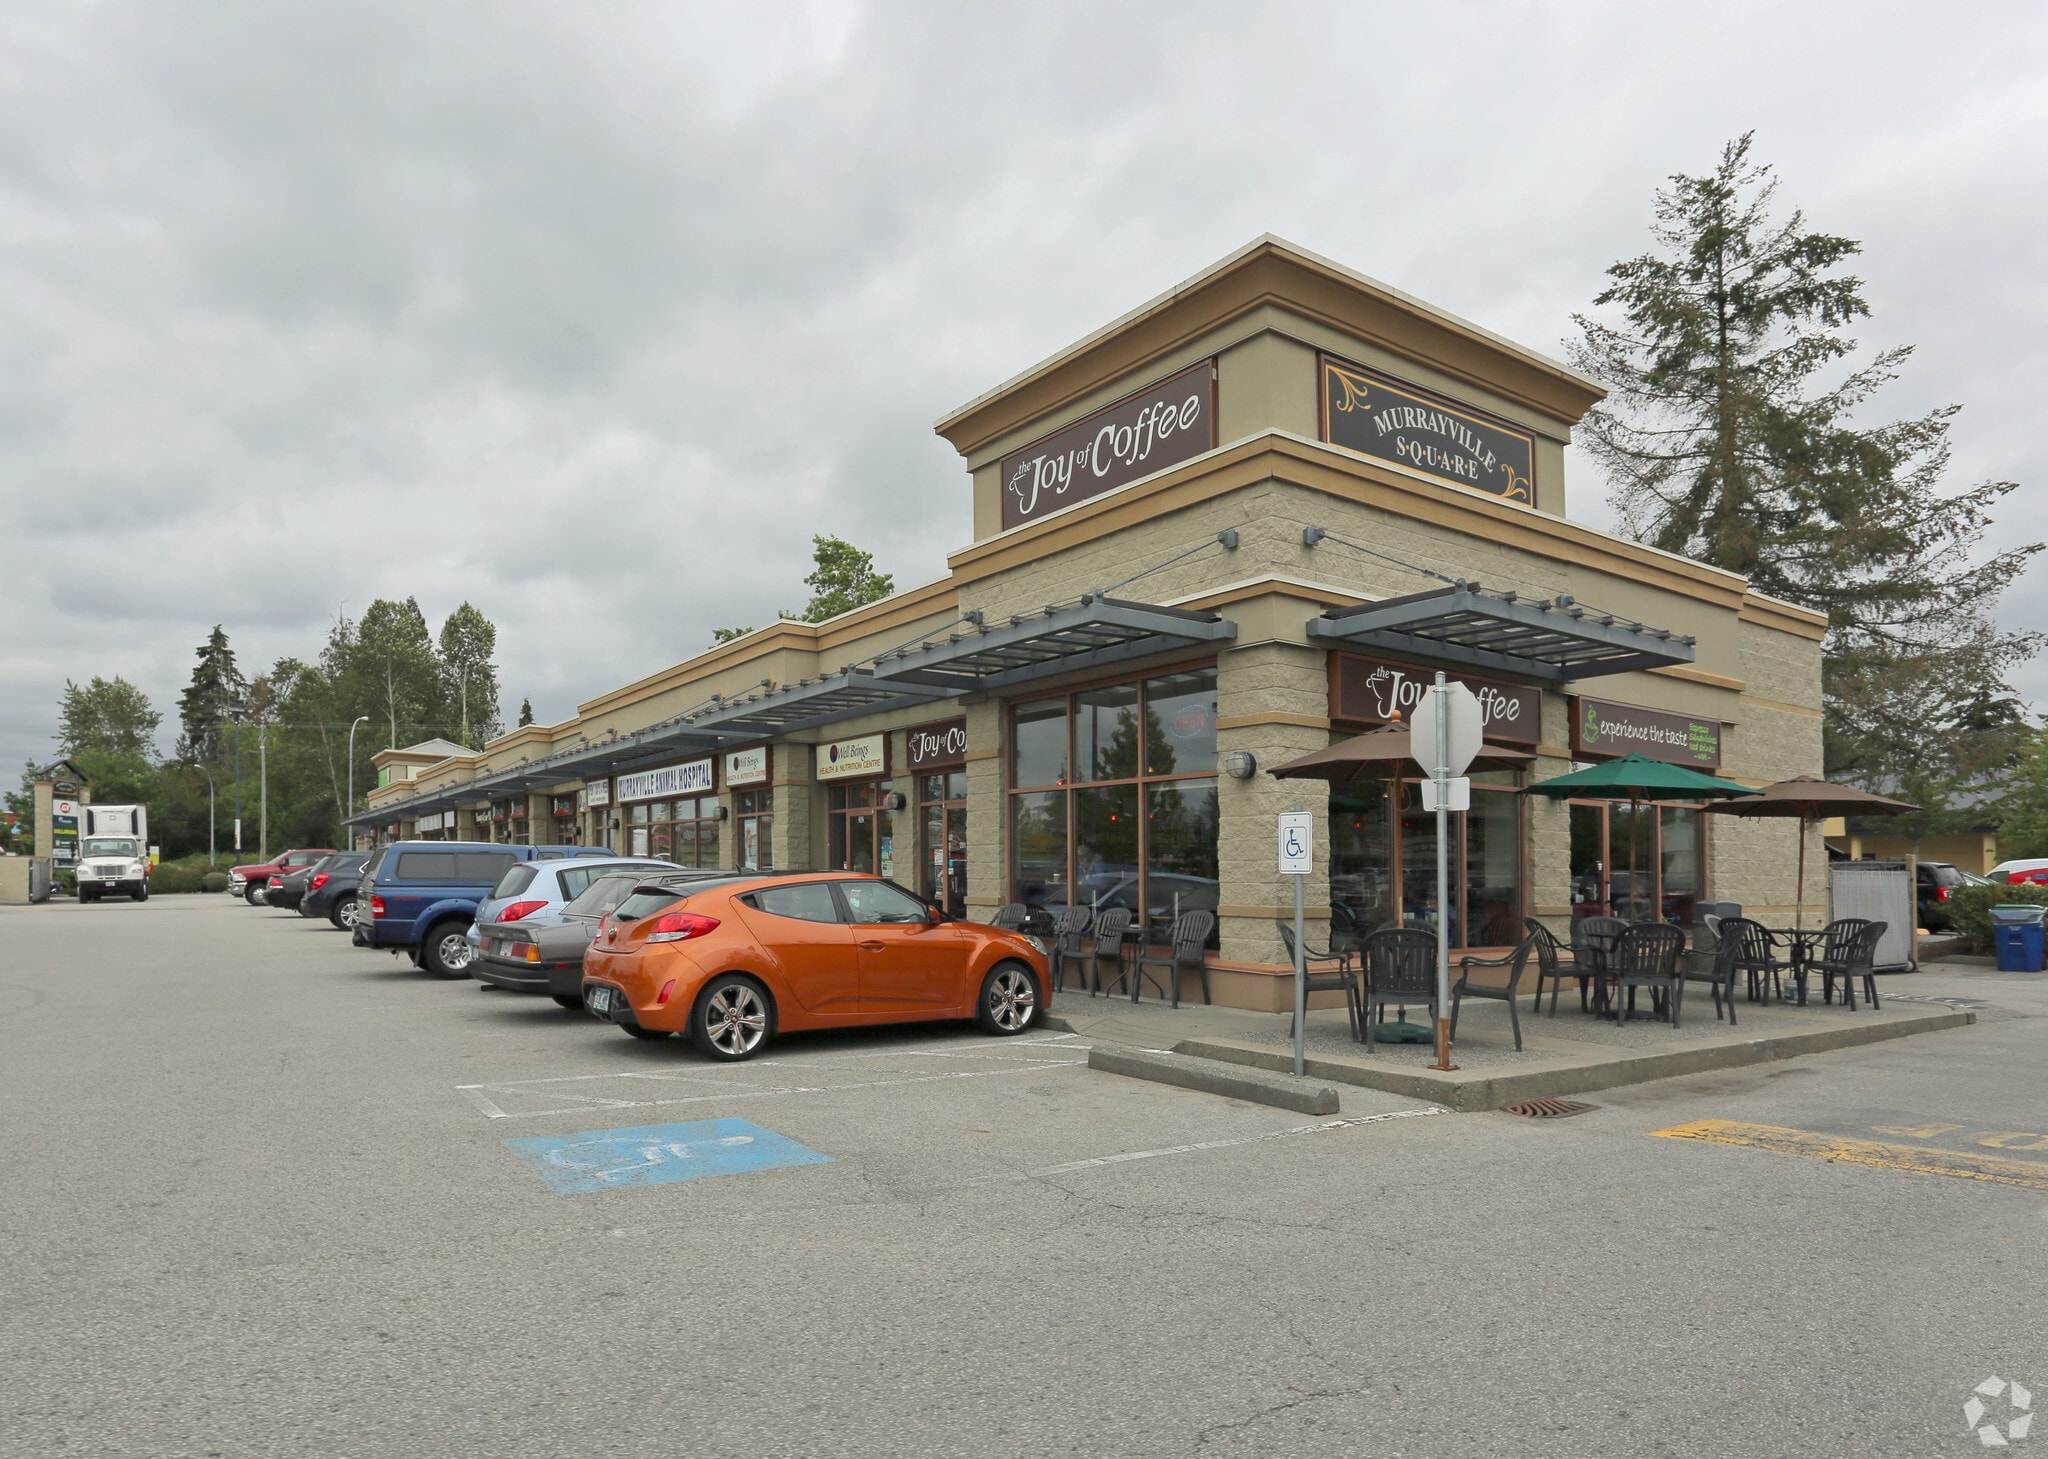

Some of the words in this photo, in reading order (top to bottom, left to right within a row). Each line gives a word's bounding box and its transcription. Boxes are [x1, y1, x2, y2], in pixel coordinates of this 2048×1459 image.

[1091, 395, 1200, 477] Coffee
[1373, 406, 1497, 473] MURRAYVILLE
[1018, 460, 1032, 475] the
[1076, 442, 1093, 468] of
[1019, 449, 1075, 515] Joy
[1376, 665, 1390, 679] the
[913, 732, 940, 763] Joy
[940, 733, 947, 747] of
[1600, 719, 1648, 743] experience
[1649, 725, 1664, 743] the
[1665, 728, 1688, 747] taste
[850, 744, 869, 762] Beings
[618, 774, 654, 799] MURRAYVILLE
[655, 769, 677, 794] ANIMAL
[678, 763, 711, 790] HOSPITAL
